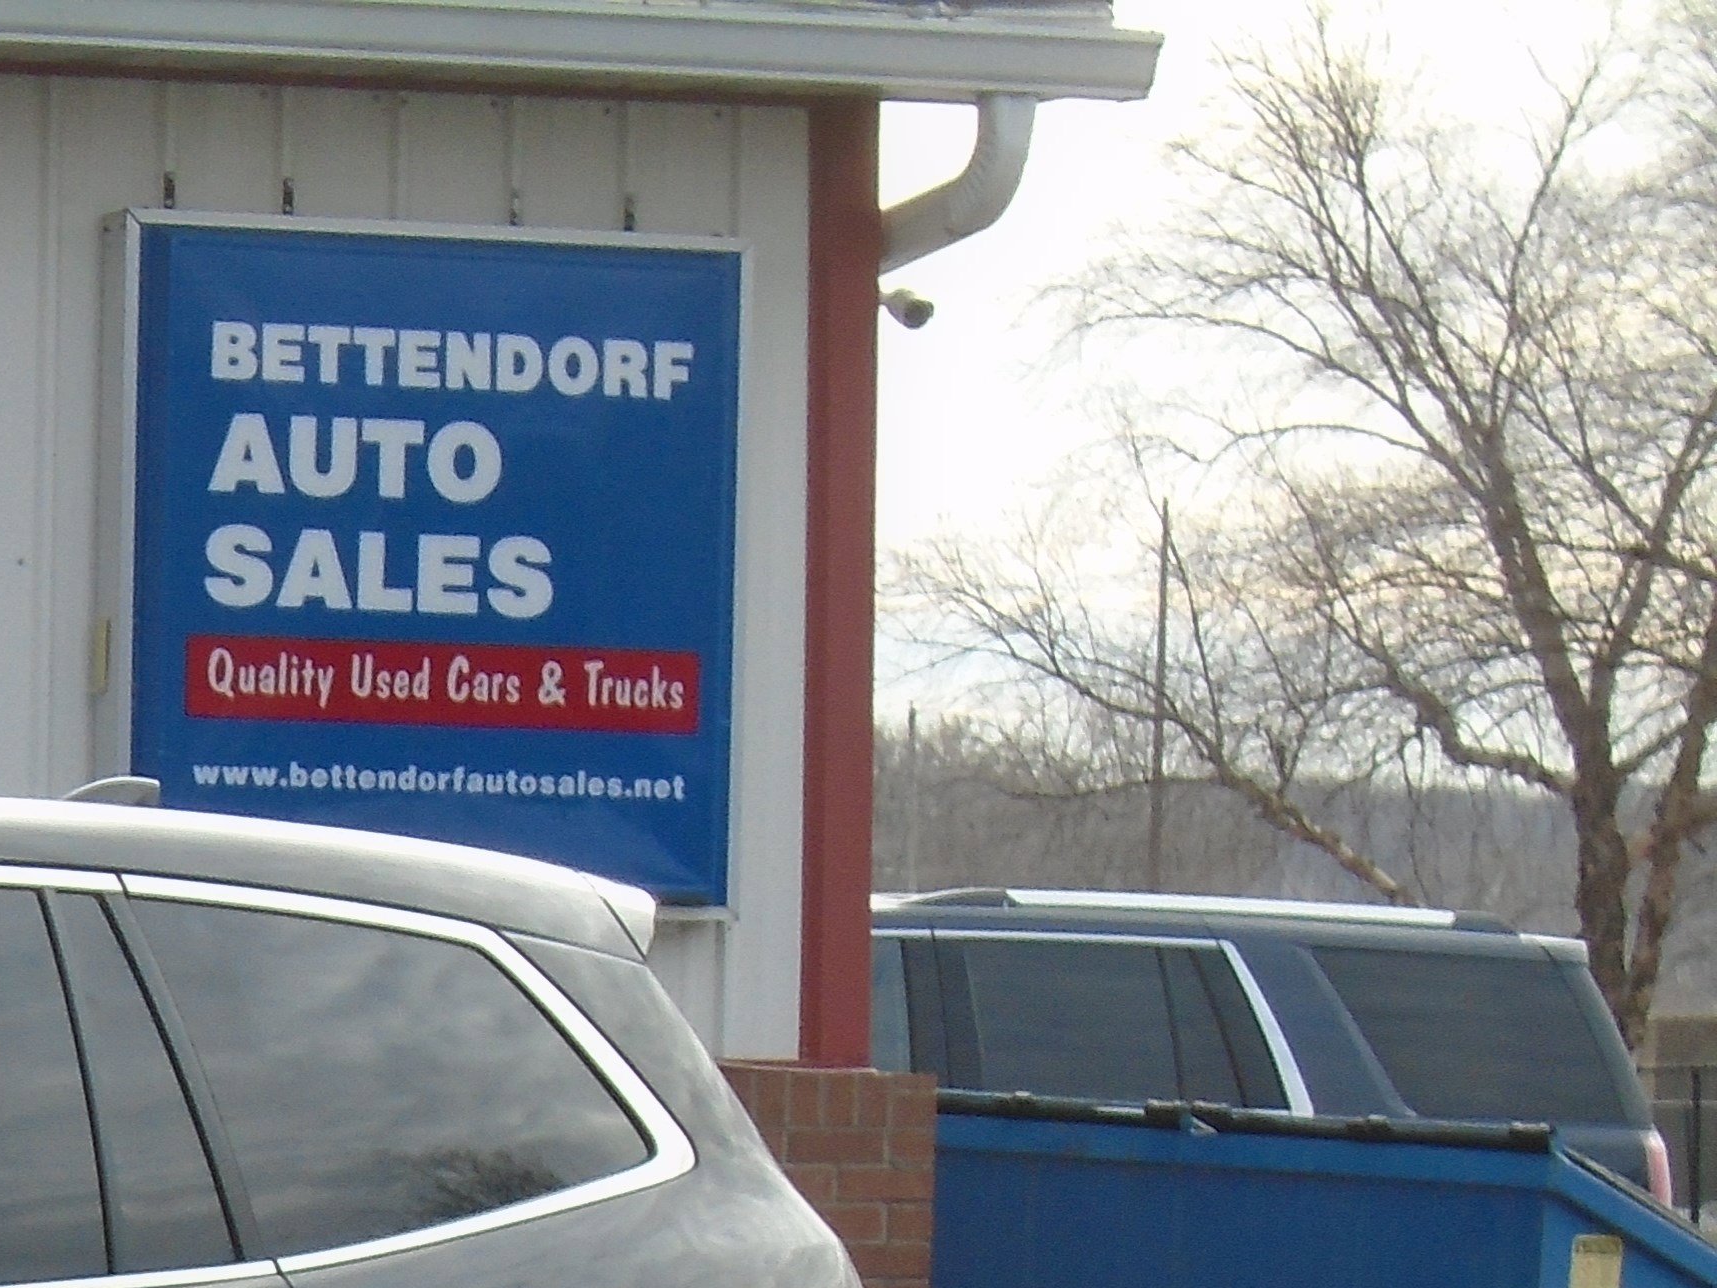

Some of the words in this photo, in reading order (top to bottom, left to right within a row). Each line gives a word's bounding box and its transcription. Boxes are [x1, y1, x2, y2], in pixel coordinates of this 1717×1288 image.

[211, 320, 695, 400] BETTENDORF
[209, 413, 502, 503] AUTO
[205, 525, 553, 618] SALES
[208, 648, 333, 707] Quality
[351, 654, 430, 701] Used
[447, 656, 520, 704] Cars
[538, 661, 565, 705] &
[584, 662, 684, 709] Trucks
[193, 761, 686, 800] www.bettendorfautosales.net
